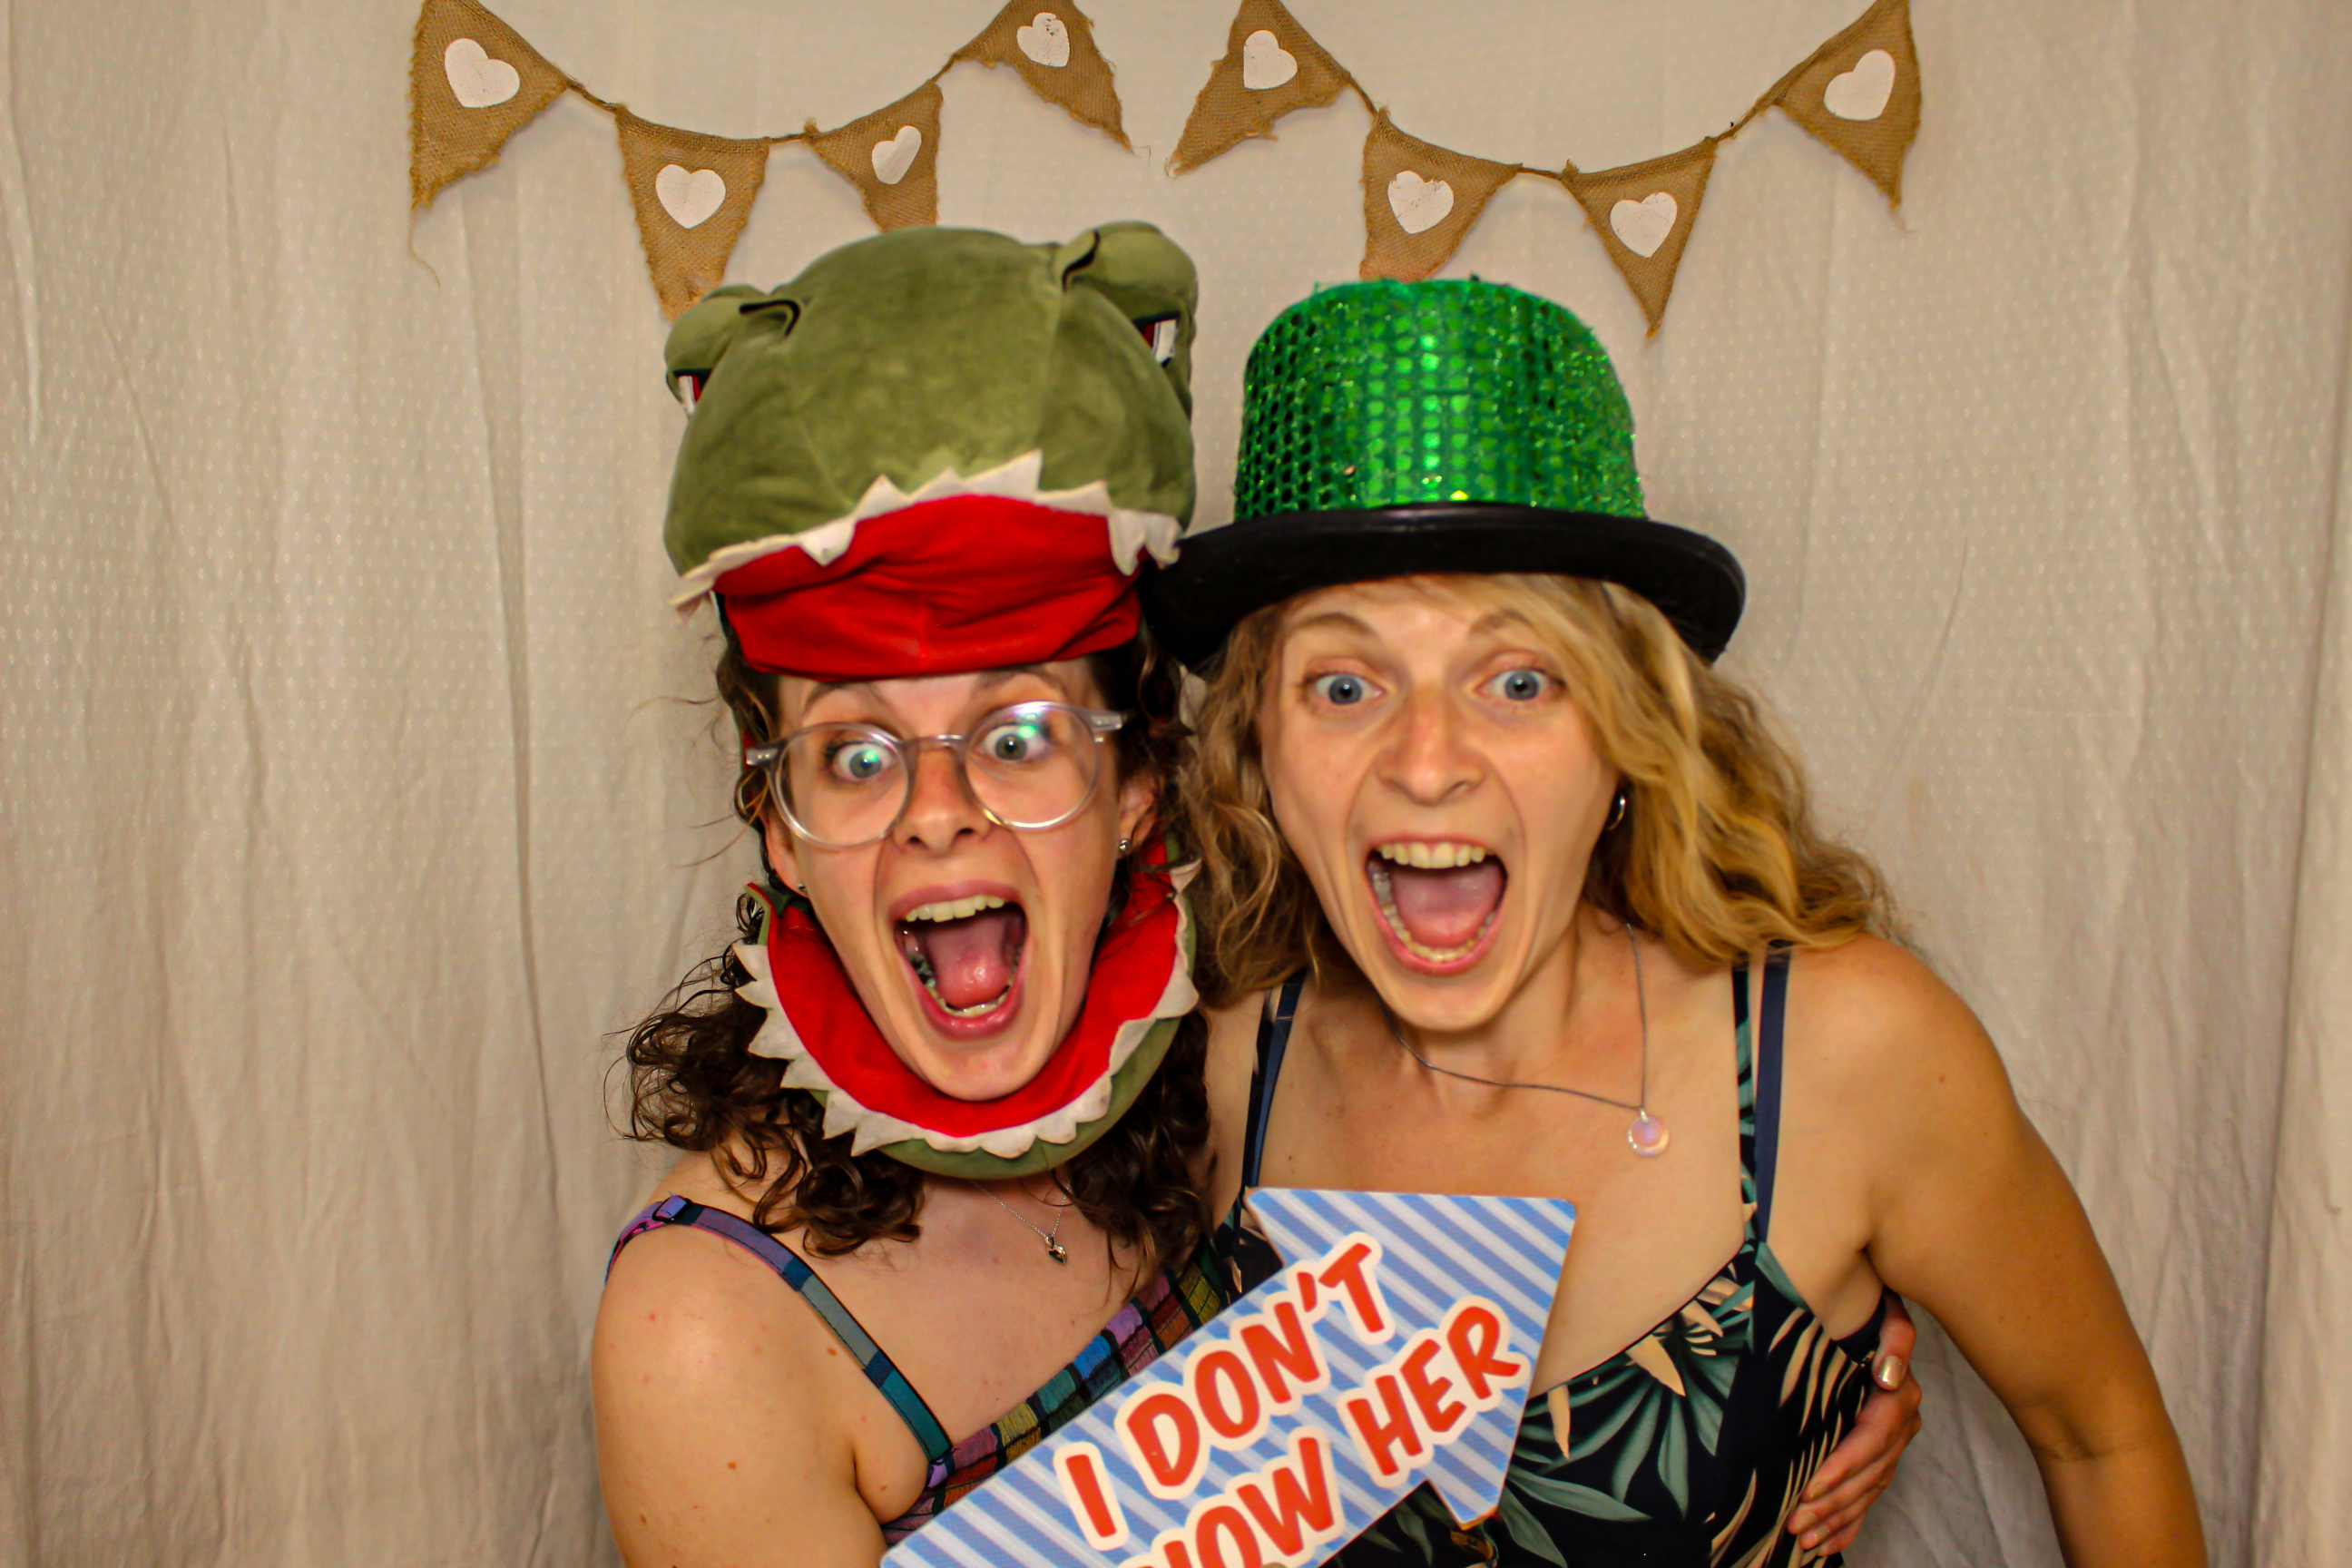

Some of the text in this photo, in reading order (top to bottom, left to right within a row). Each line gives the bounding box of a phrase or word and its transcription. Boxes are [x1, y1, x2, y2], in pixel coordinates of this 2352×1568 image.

[1065, 1242, 1385, 1537] I DON'T
[1134, 1306, 1522, 1568] OW HER
